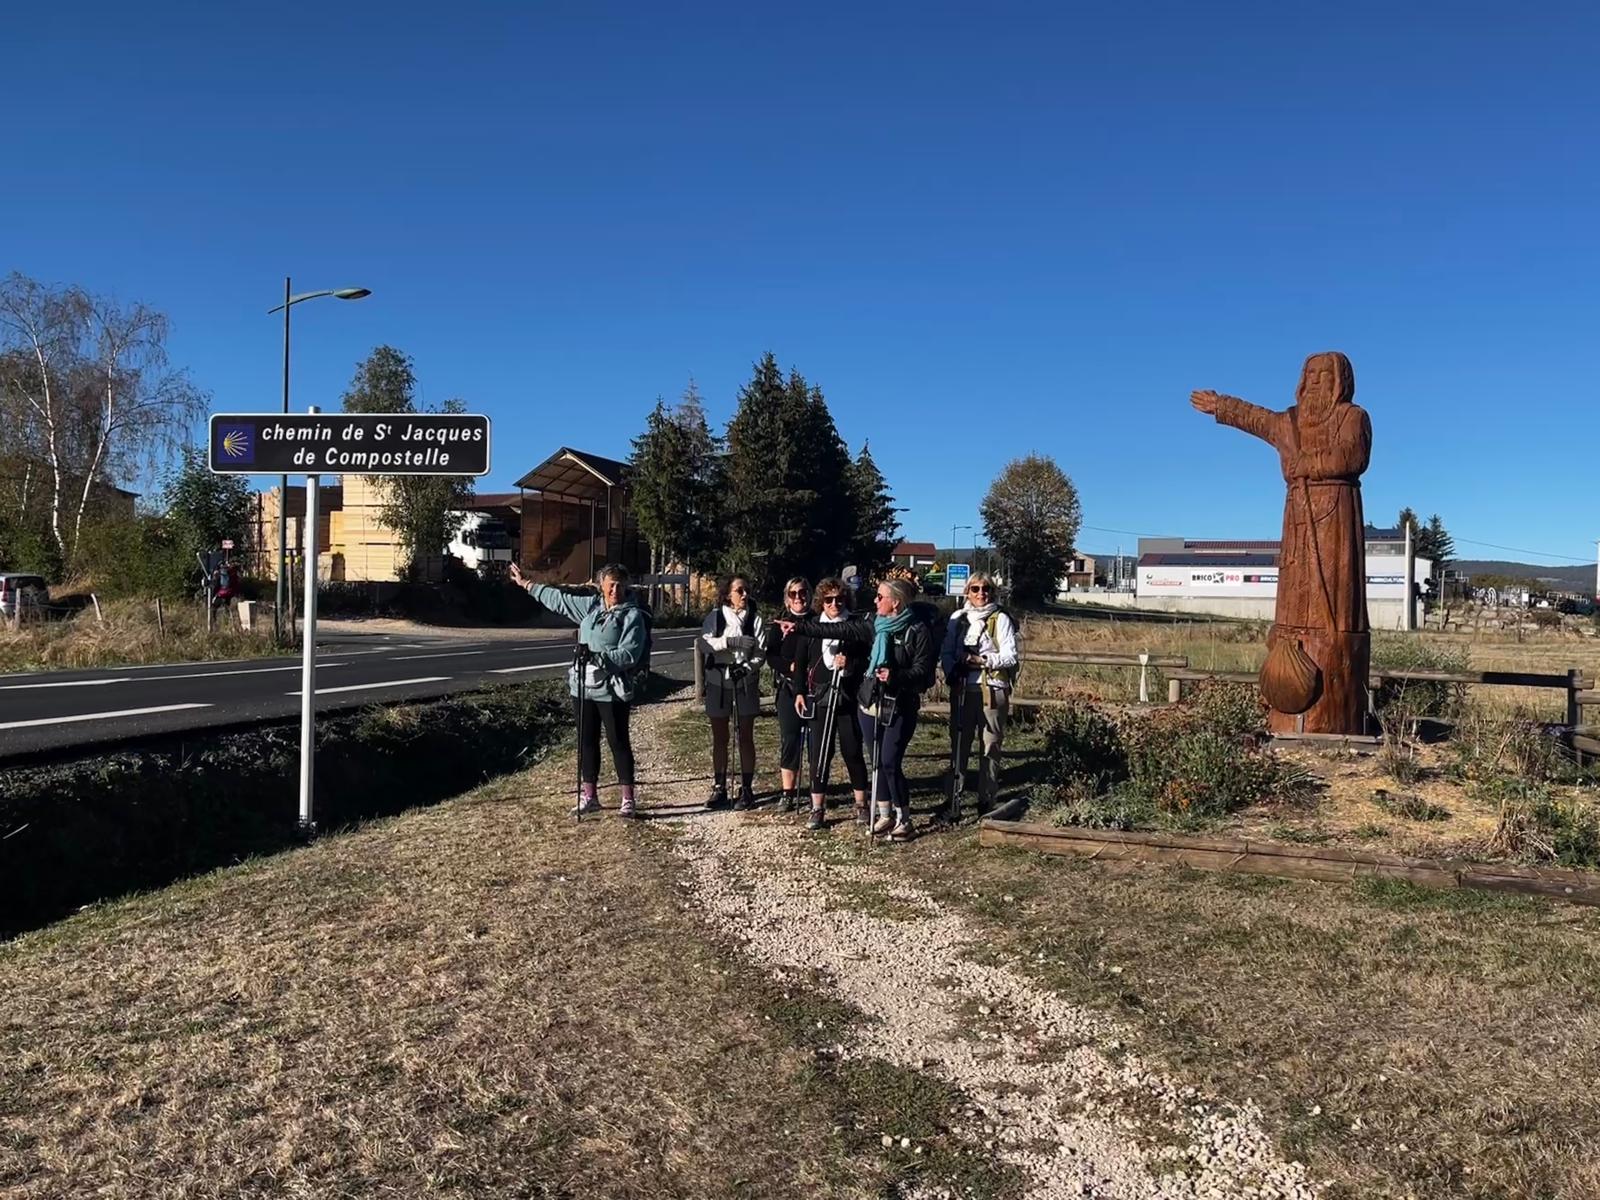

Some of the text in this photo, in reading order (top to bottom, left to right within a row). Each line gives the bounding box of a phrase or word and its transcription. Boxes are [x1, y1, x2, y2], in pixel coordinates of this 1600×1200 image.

[261, 423, 332, 441] chemin
[341, 423, 364, 440] de
[401, 424, 483, 445] Jacques
[293, 448, 450, 468] de Compostelle
